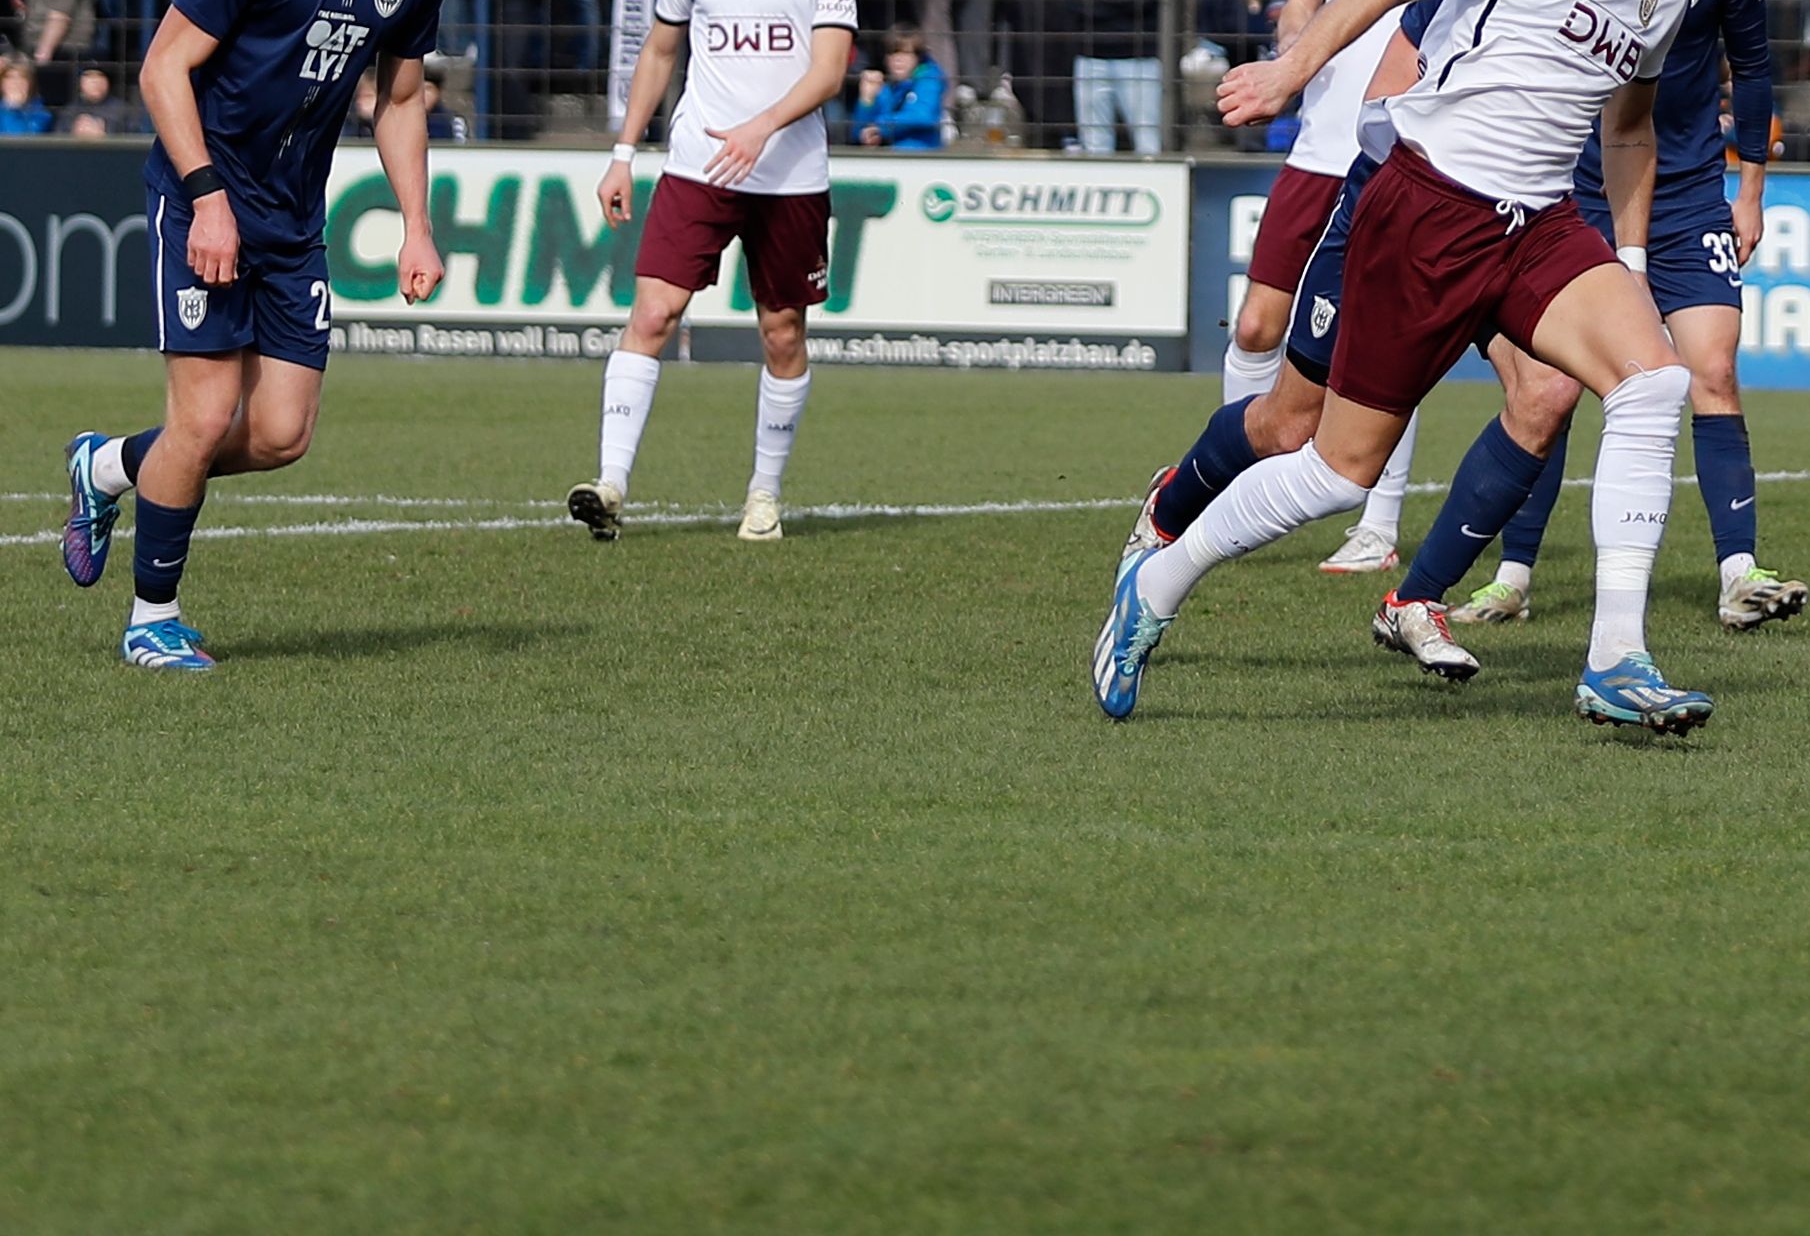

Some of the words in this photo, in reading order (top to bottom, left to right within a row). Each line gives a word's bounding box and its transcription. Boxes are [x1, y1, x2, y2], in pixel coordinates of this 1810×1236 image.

[299, 49, 349, 82] LY!
[965, 185, 1139, 214] SCHMITT
[1702, 232, 1739, 273] 33
[349, 321, 415, 353] Ihren
[416, 324, 495, 354] Rasen
[496, 325, 544, 356] voll
[546, 326, 580, 357] im
[1620, 511, 1668, 525] JAKO
